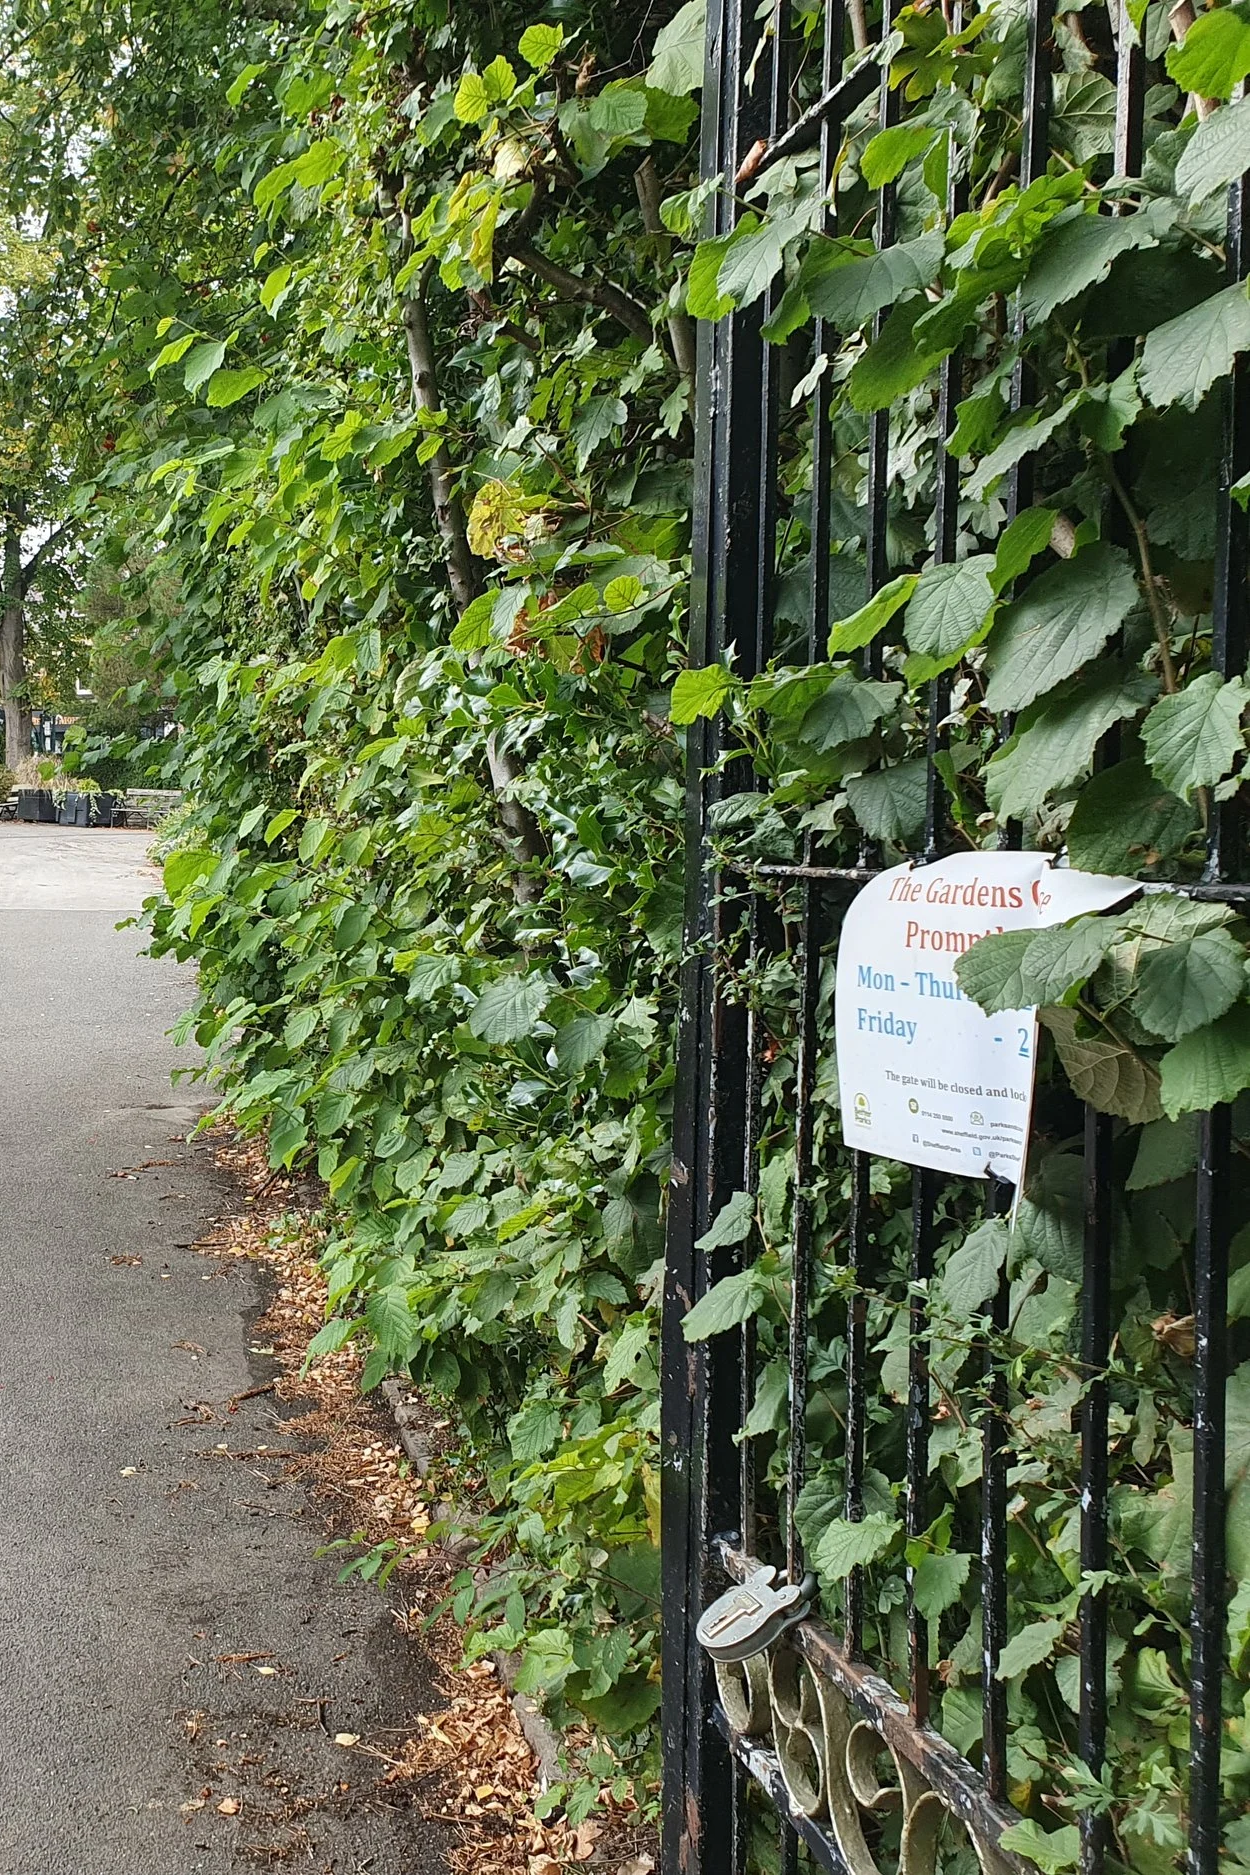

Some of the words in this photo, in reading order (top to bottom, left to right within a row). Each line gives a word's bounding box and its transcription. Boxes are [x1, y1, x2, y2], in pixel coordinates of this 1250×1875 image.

[888, 876, 923, 902] The
[926, 877, 1023, 909] Gardens
[857, 964, 896, 992] Mon
[857, 1007, 918, 1045] Friday
[885, 1069, 901, 1082] The
[902, 1075, 919, 1086] gate
[920, 1078, 936, 1089] will
[938, 1079, 949, 1091] be
[950, 1082, 983, 1096] closed
[985, 1087, 1008, 1098] and
